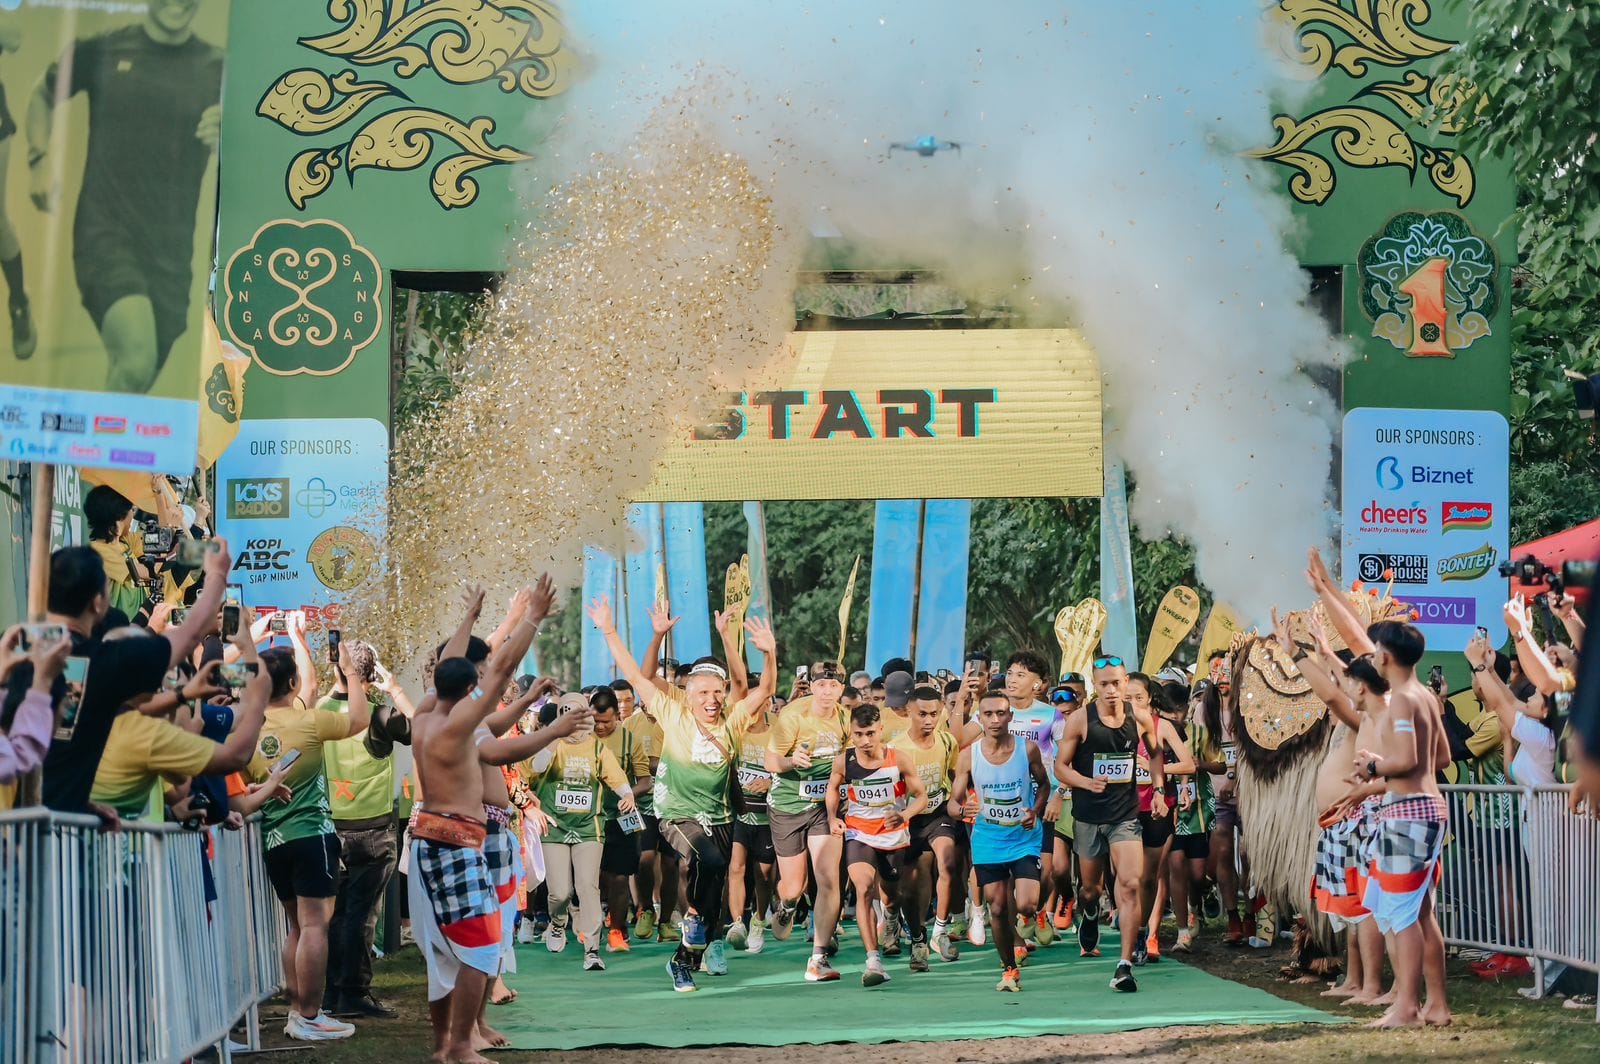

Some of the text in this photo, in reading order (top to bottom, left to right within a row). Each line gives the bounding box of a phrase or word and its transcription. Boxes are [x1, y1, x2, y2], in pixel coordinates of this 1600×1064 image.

[1376, 428, 1401, 444] OUR
[250, 440, 276, 456] OUR
[1412, 466, 1474, 484] Biznet
[235, 501, 282, 515] RADIO
[1361, 500, 1428, 524] cheers
[246, 539, 281, 550] KOPI
[232, 551, 291, 570] ABC
[1389, 555, 1428, 567] SPORT
[1438, 550, 1495, 573] BONTEH
[250, 571, 299, 584] SIAP MINUM
[1391, 567, 1428, 580] HOUSE
[1416, 602, 1466, 618] TOYU
[1098, 763, 1129, 774] 0557
[560, 794, 588, 805] 0956
[858, 788, 888, 799] 0941
[990, 807, 1020, 818] 0942
